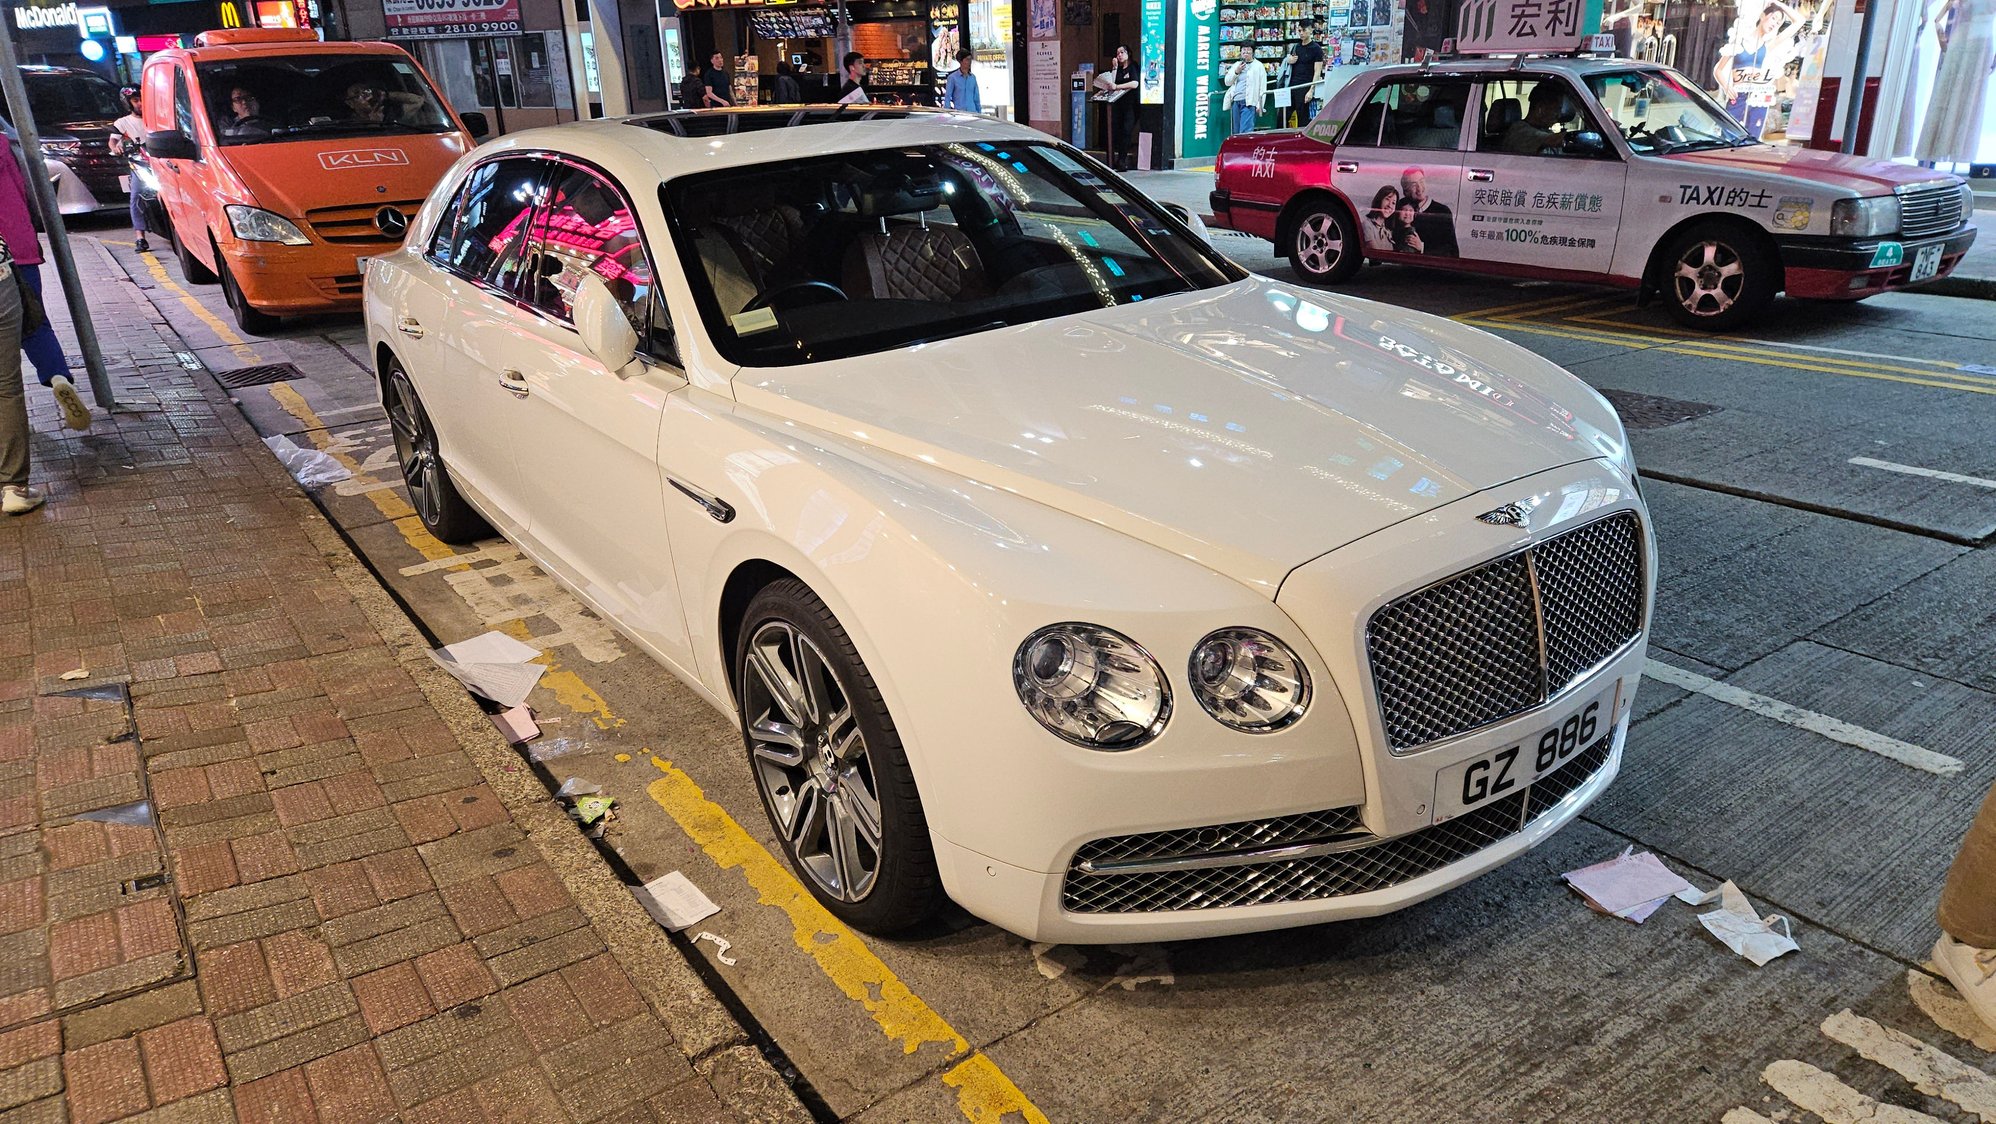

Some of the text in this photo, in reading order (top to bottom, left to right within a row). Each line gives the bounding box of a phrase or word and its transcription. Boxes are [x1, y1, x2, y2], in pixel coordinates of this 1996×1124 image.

[1508, 0, 1577, 39] 宏利
[444, 23, 477, 34] 2810
[481, 21, 518, 32] 9900
[1196, 25, 1211, 71] MARKET
[1594, 36, 1614, 48] TAXI
[1194, 74, 1209, 140] WHOLESOME
[1312, 124, 1338, 137] POAD
[328, 152, 399, 165] KLN
[1252, 146, 1278, 161] 的士
[1251, 162, 1275, 179] TAXI
[1886, 247, 1893, 258] 4
[1462, 701, 1599, 805] GZ 886
